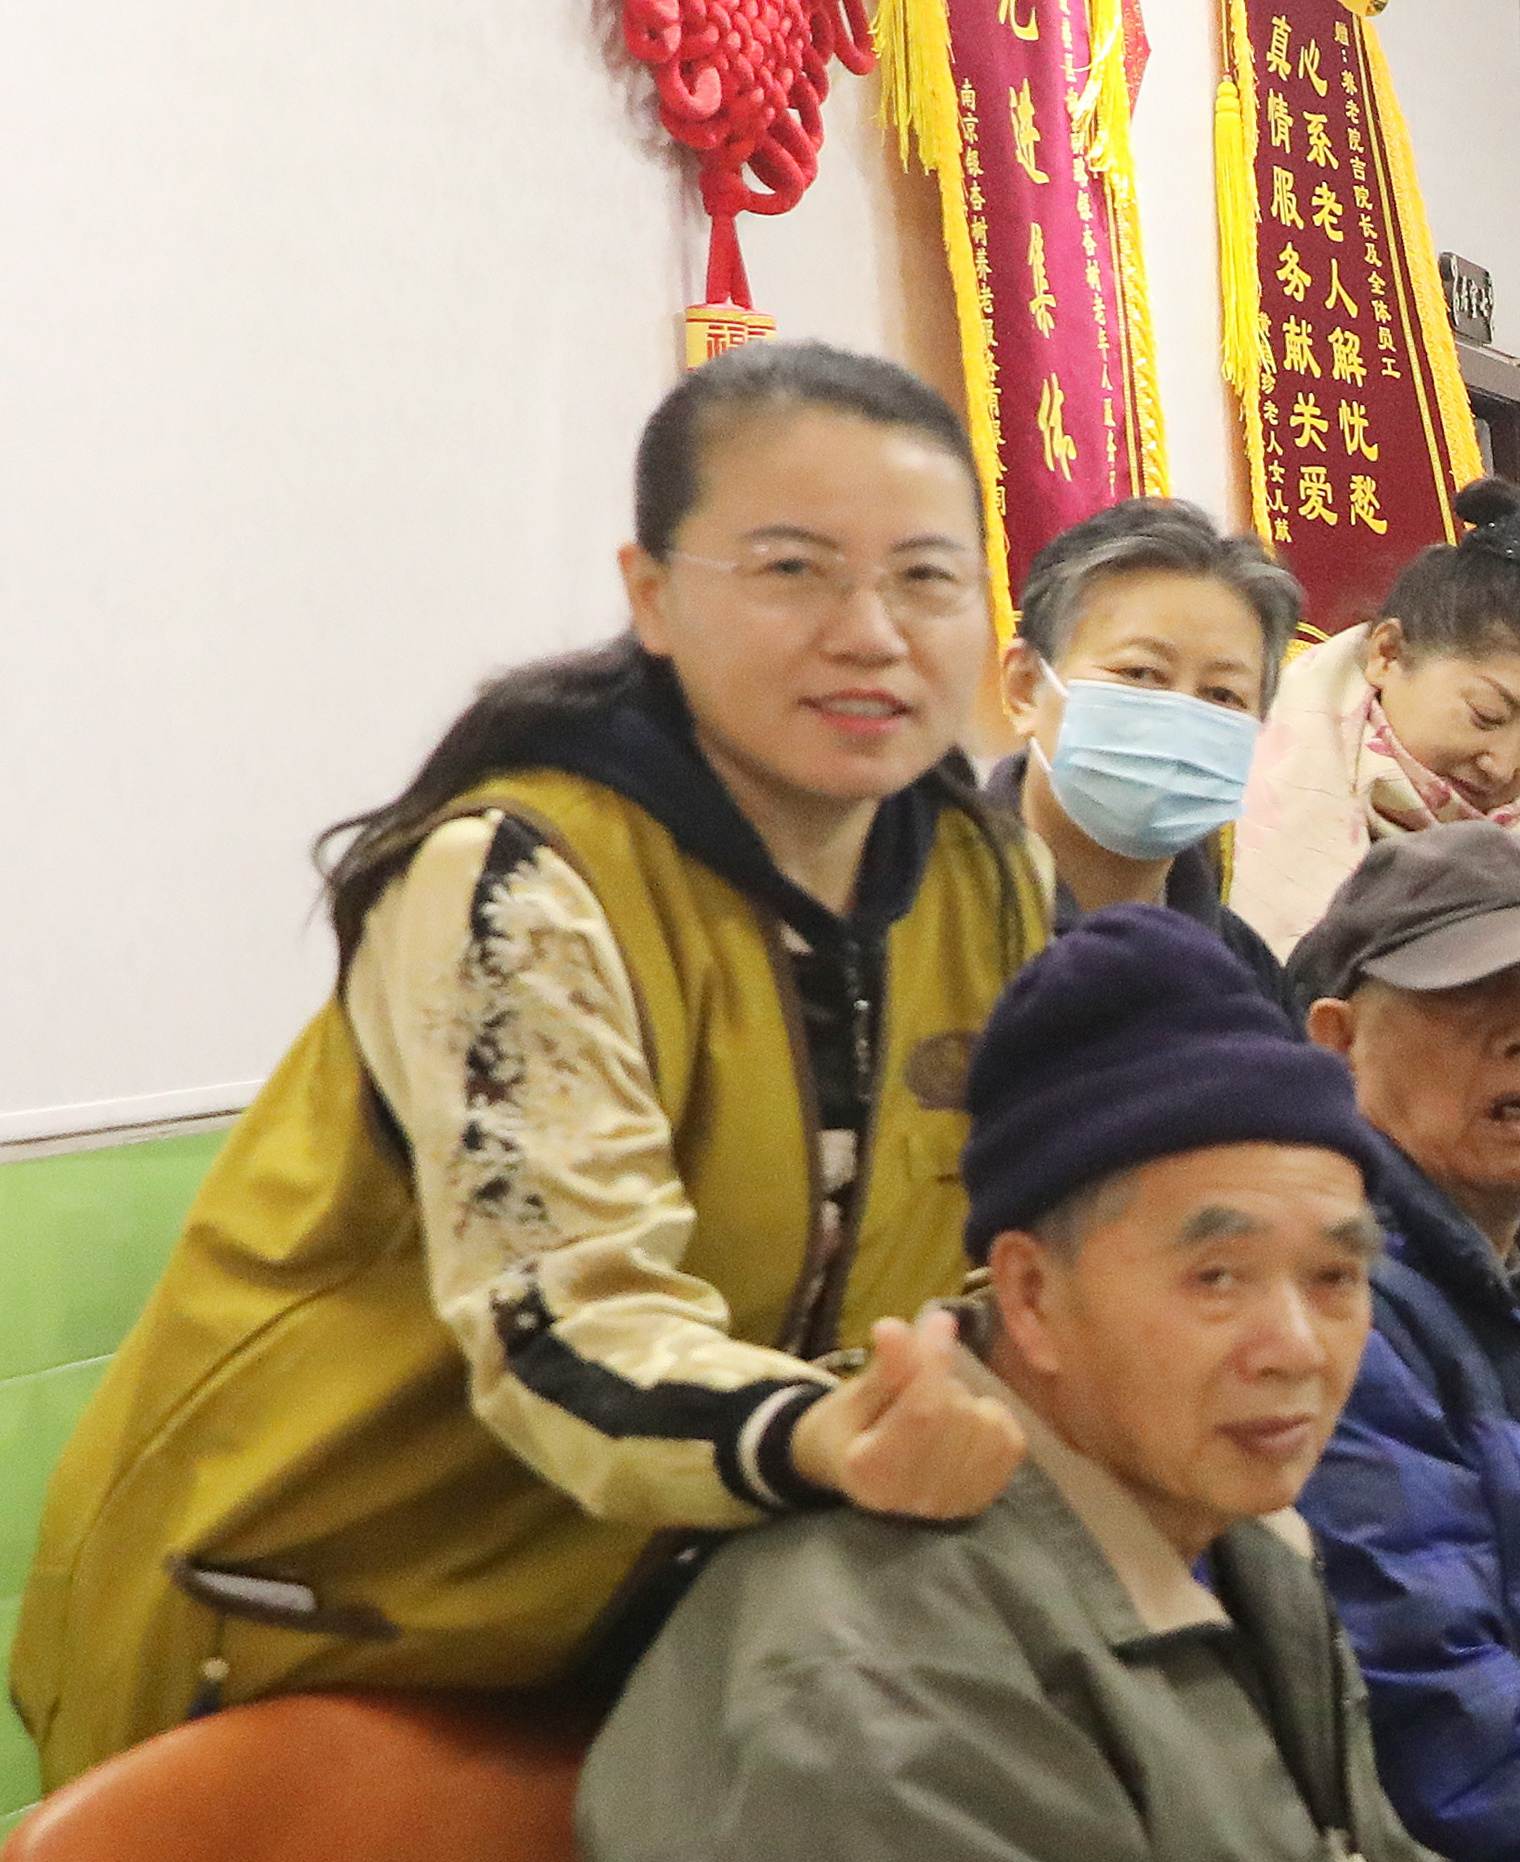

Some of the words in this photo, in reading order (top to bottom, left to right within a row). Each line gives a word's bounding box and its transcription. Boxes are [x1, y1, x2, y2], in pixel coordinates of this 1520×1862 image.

[1266, 15, 1338, 526] 真情服务献关爱
[1298, 38, 1388, 535] 心系老人解忧愁
